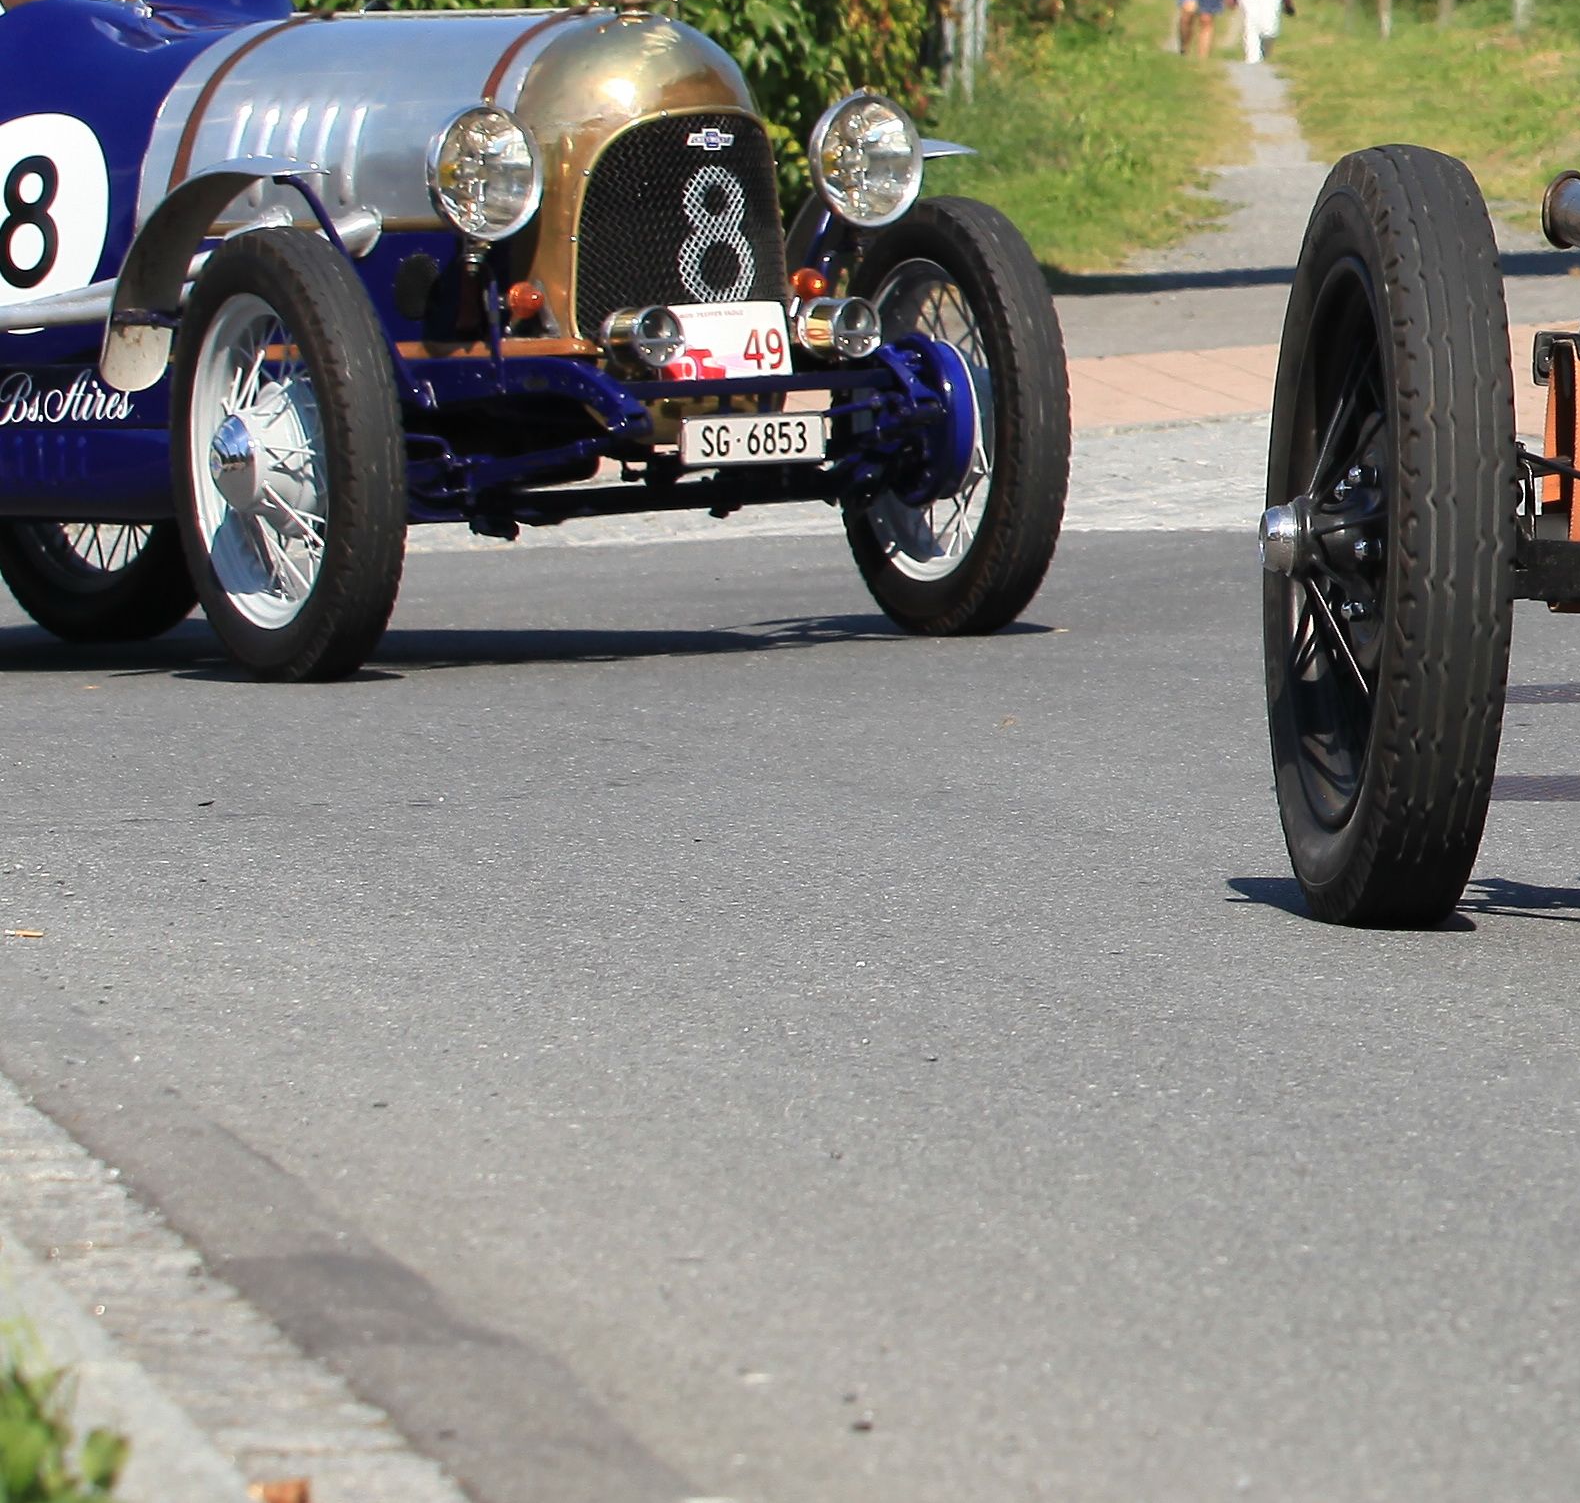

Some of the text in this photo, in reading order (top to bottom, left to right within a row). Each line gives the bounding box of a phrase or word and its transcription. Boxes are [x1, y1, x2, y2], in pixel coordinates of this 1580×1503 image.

[0, 154, 59, 289] 8
[678, 164, 756, 303] 8
[743, 327, 784, 370] 49
